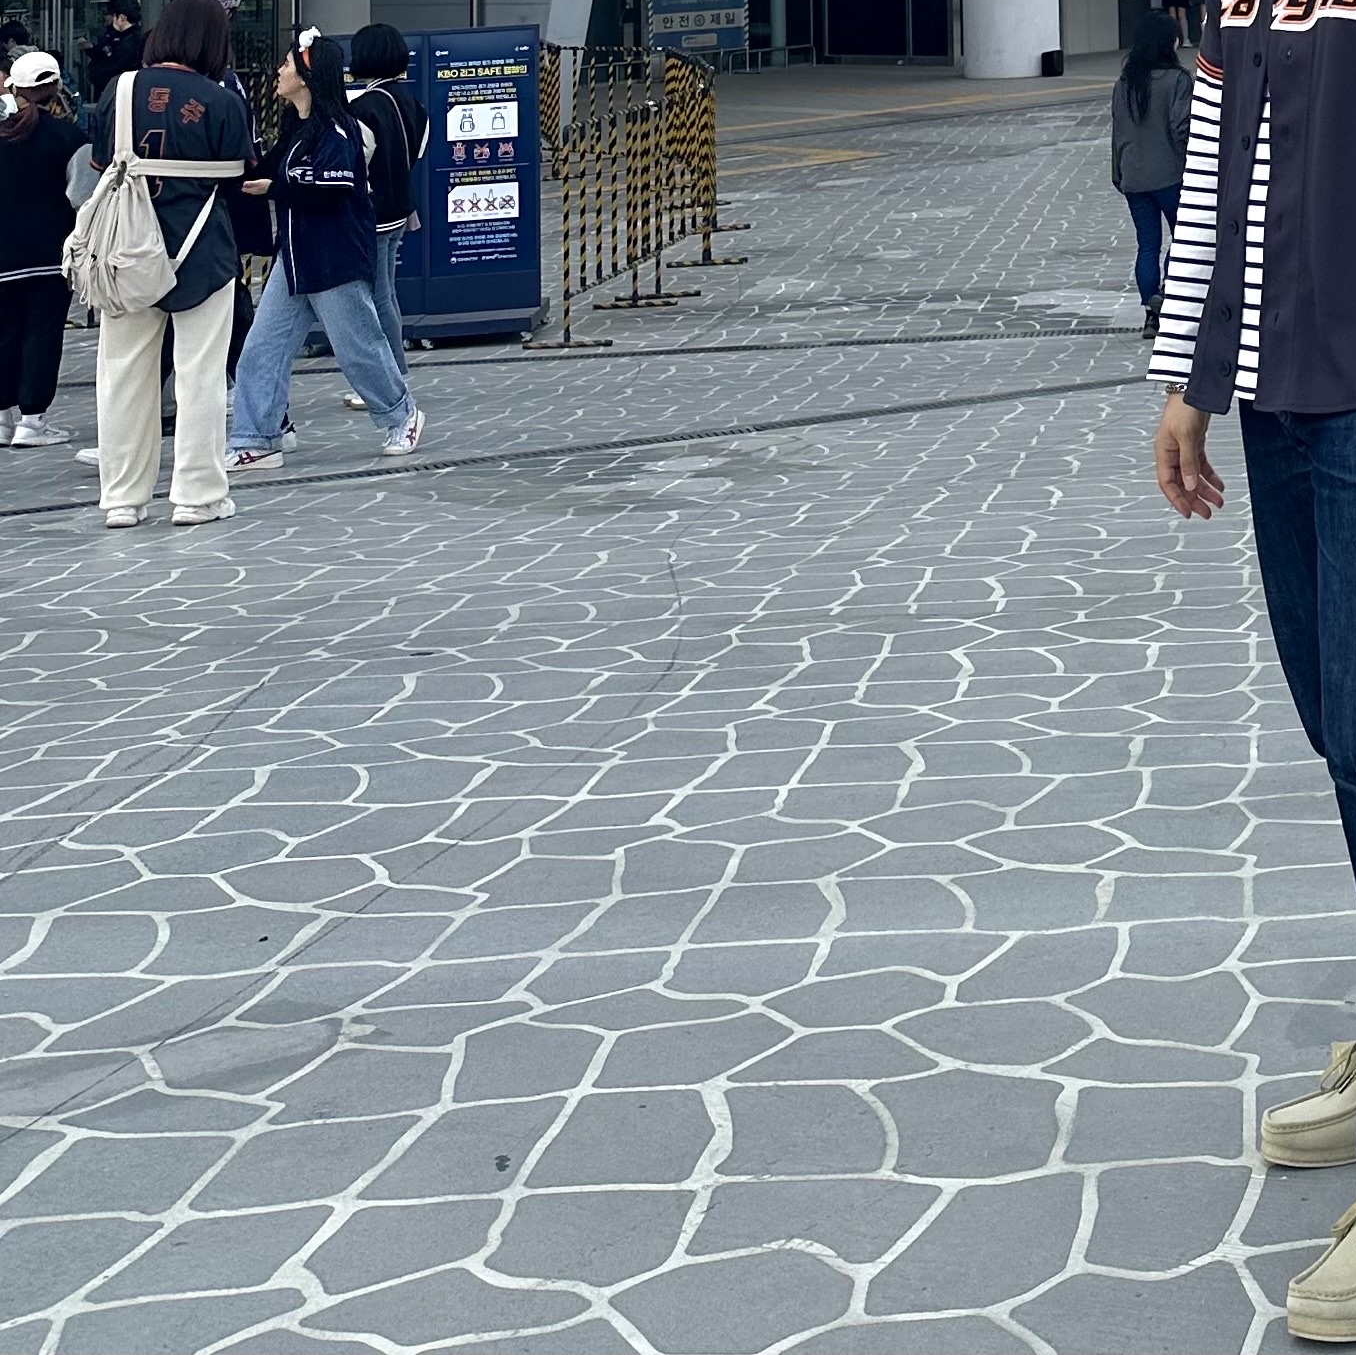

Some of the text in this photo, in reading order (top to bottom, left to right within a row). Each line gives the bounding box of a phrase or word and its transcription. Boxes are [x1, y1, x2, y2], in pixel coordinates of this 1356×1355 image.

[662, 15, 690, 29] 안전
[437, 69, 459, 79] KBO
[477, 66, 502, 77] SAFE
